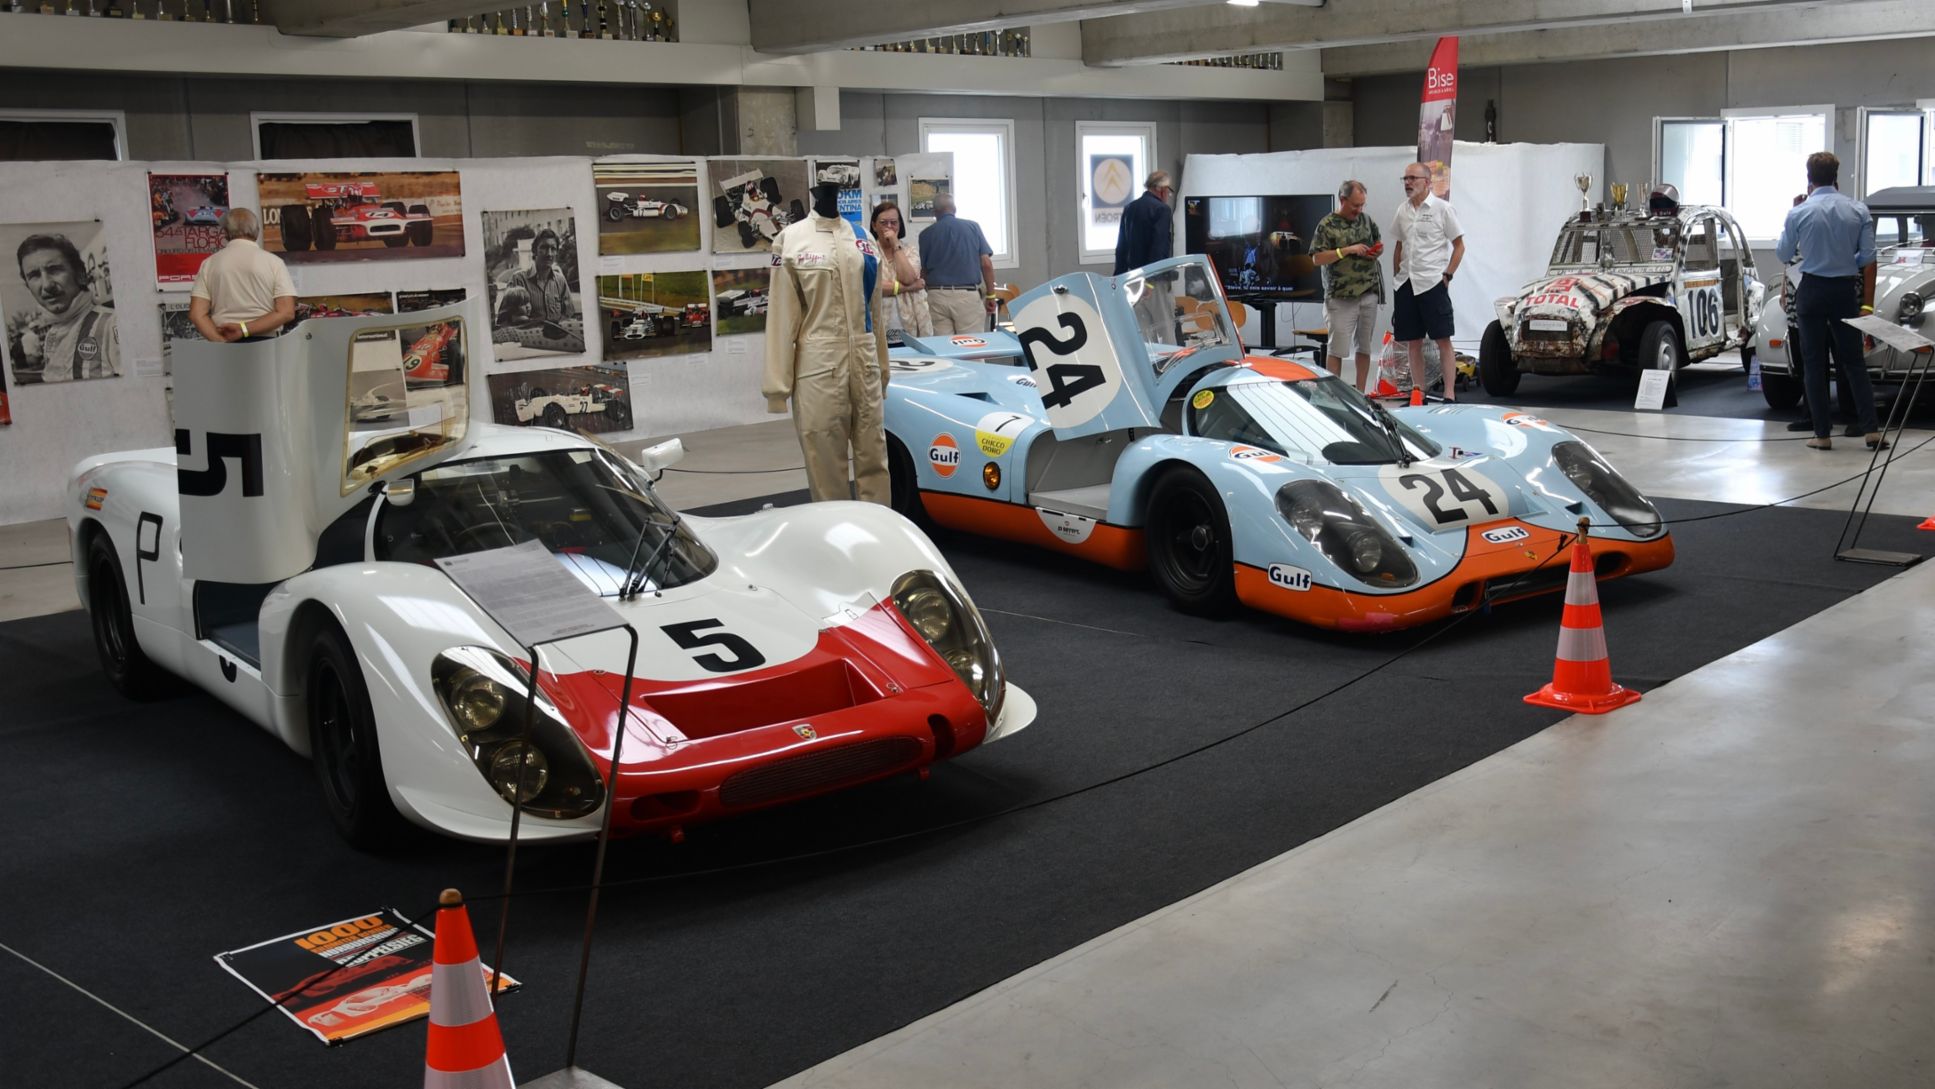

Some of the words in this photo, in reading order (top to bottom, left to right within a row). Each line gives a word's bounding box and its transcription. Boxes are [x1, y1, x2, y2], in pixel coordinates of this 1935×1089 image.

[1428, 67, 1455, 88] Bise
[1526, 293, 1580, 310] TOTAL
[1687, 288, 1720, 339] 106
[1018, 311, 1107, 410] 24
[930, 448, 959, 463] Gulf
[981, 438, 1006, 450] CHICCO
[175, 428, 264, 498] 5
[1398, 468, 1499, 525] 24
[1485, 528, 1526, 542] Gulf
[136, 511, 164, 606] P
[1269, 565, 1311, 589] Gulf
[659, 618, 766, 672] 5
[293, 916, 384, 951] 1000
